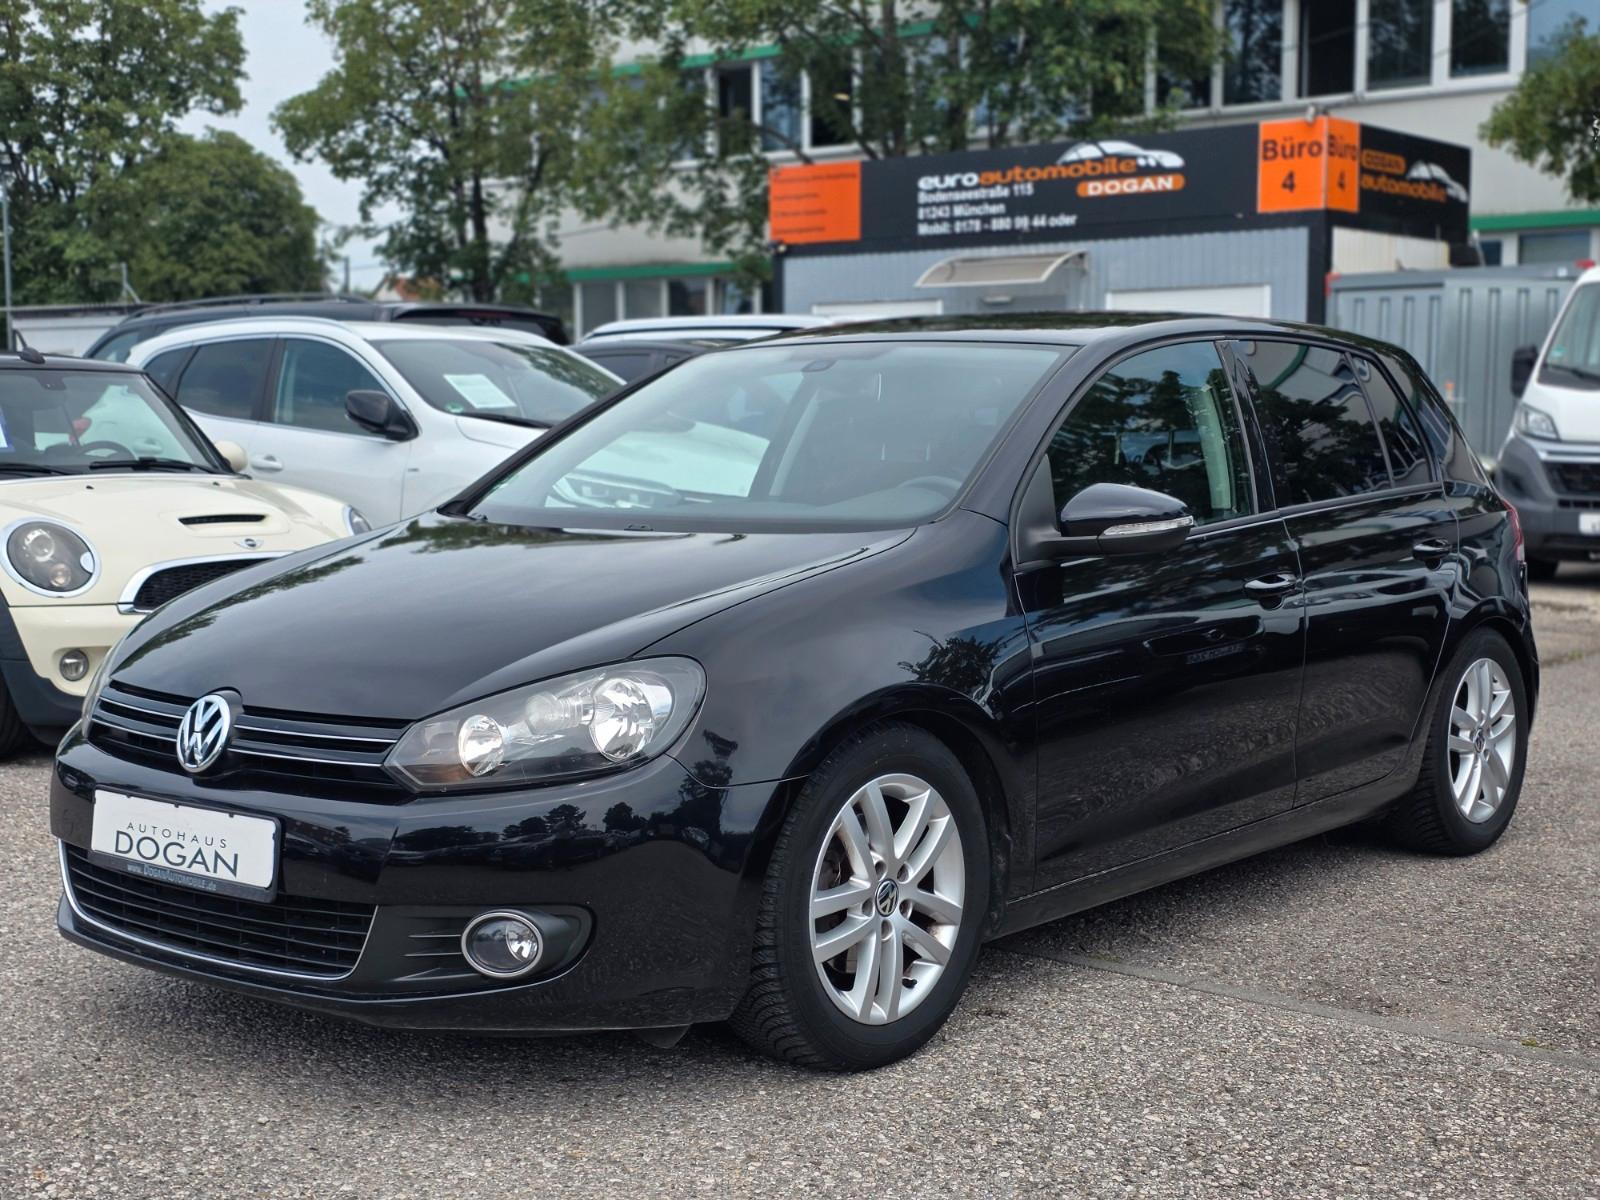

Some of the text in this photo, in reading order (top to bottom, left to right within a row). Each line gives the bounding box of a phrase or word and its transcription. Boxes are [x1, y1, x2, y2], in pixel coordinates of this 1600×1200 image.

[1262, 136, 1323, 161] Büro
[1087, 176, 1173, 196] DOGAN
[1281, 170, 1296, 192] 4
[1337, 170, 1346, 192] 4
[953, 202, 1006, 218] München
[1032, 213, 1047, 227] 44
[1048, 212, 1078, 227] oder
[126, 822, 227, 849] AUTOHAUS
[114, 830, 239, 878] DOGAN
